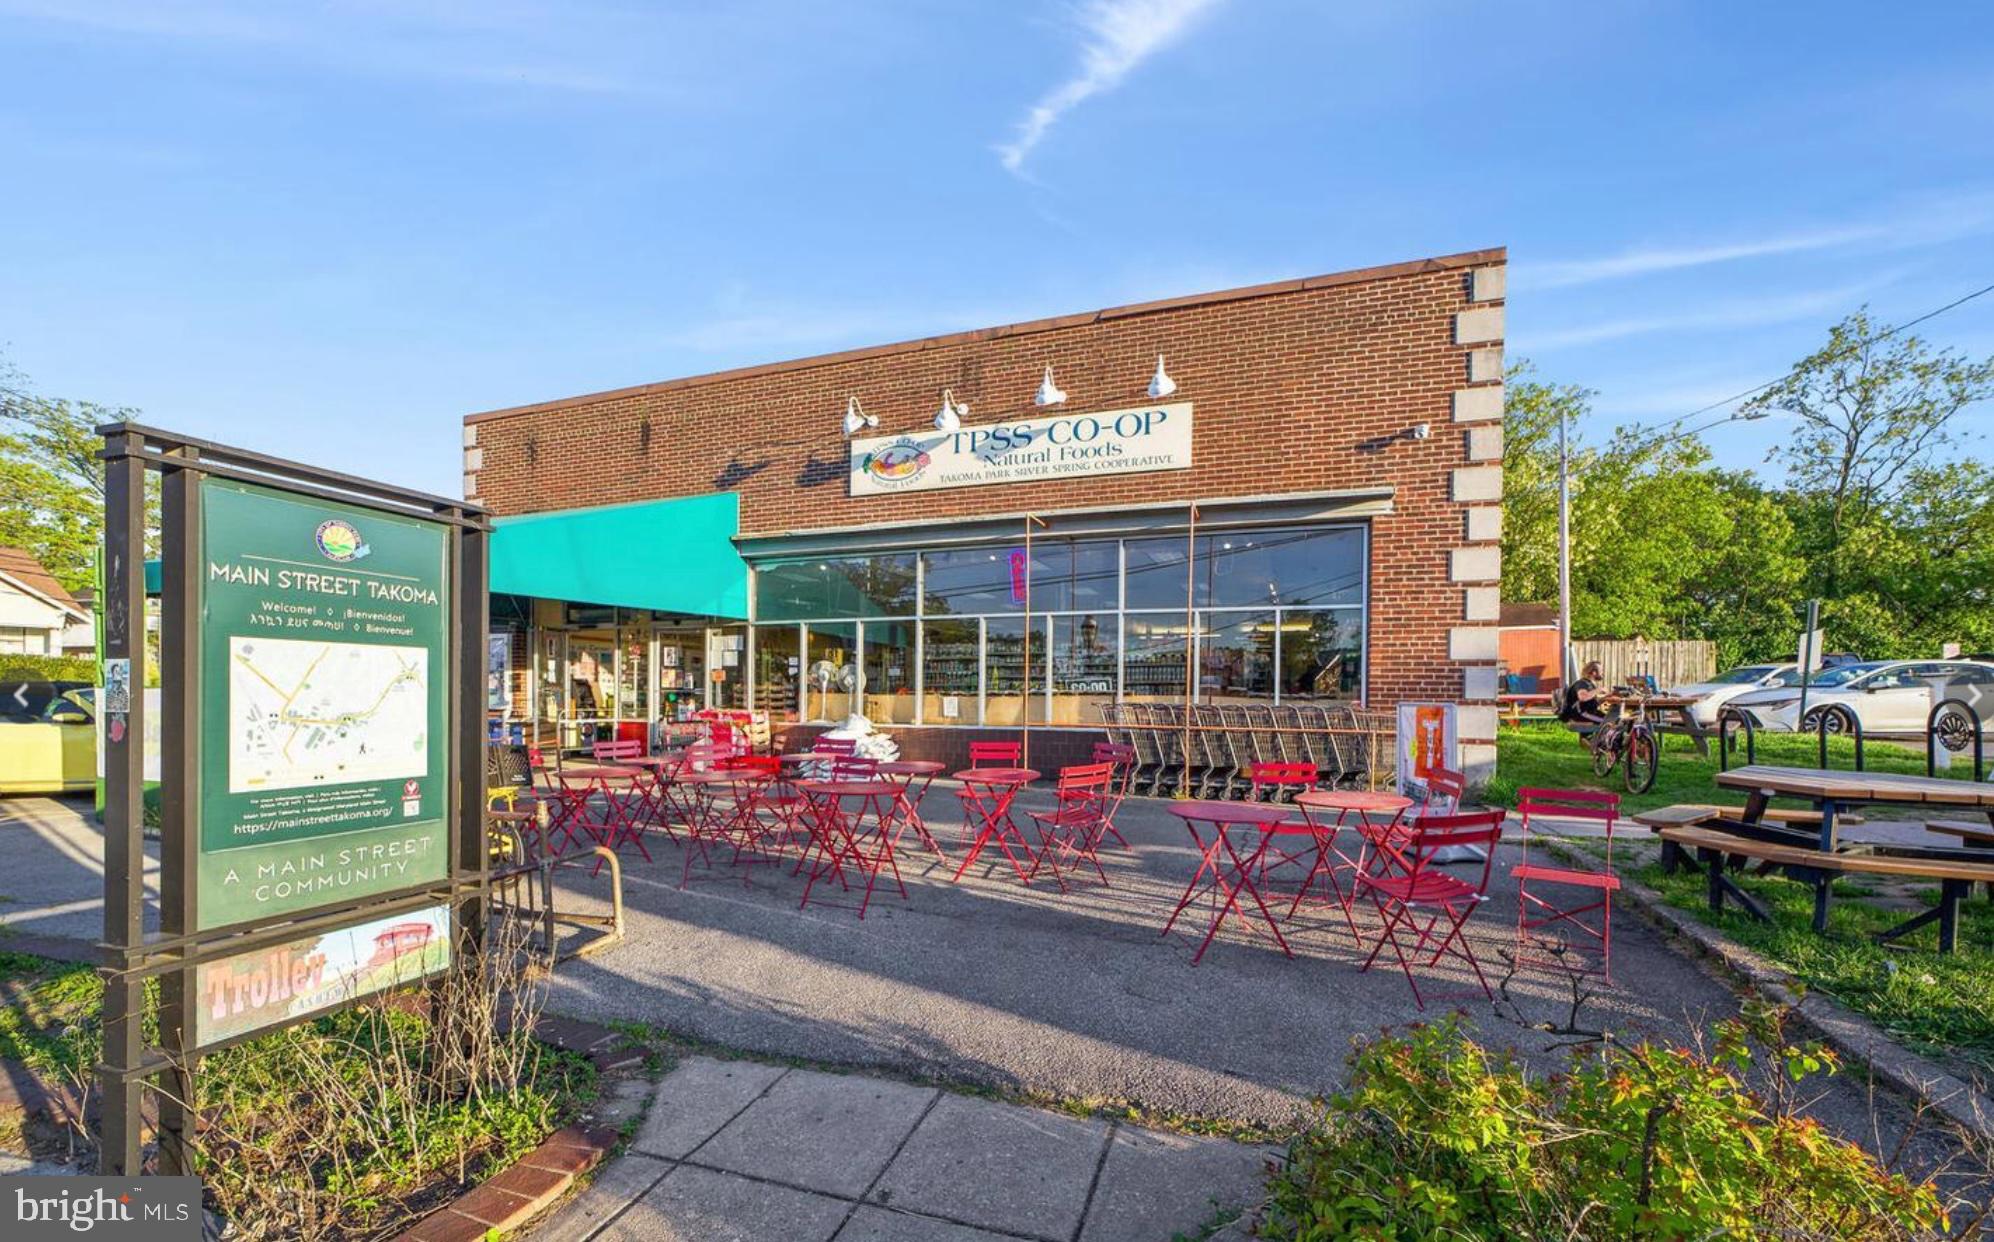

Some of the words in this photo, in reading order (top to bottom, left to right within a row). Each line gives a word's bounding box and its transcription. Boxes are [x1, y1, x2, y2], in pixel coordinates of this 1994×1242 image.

[950, 424, 1033, 454] TPSS
[1047, 410, 1167, 445] CO-OP
[939, 470, 982, 483] TAKOMA
[984, 468, 1011, 479] PARK
[1052, 460, 1090, 473] SPRING
[1094, 454, 1174, 470] COOPERATIVE
[983, 447, 1050, 468] Natural
[1060, 441, 1122, 461] Foods
[209, 562, 270, 586] MAIN
[278, 570, 361, 597] STREET
[367, 581, 439, 606] TAKOMA
[261, 600, 317, 616] Welcome!
[343, 609, 406, 623] ¡Bienvenidos!
[366, 622, 414, 636] Bienvenue!
[233, 806, 393, 835] https://mainstreettakoma.org/
[223, 869, 240, 885] A
[258, 853, 325, 880] MAIN
[339, 836, 431, 866] STREET
[255, 859, 408, 902] COMMUNITY
